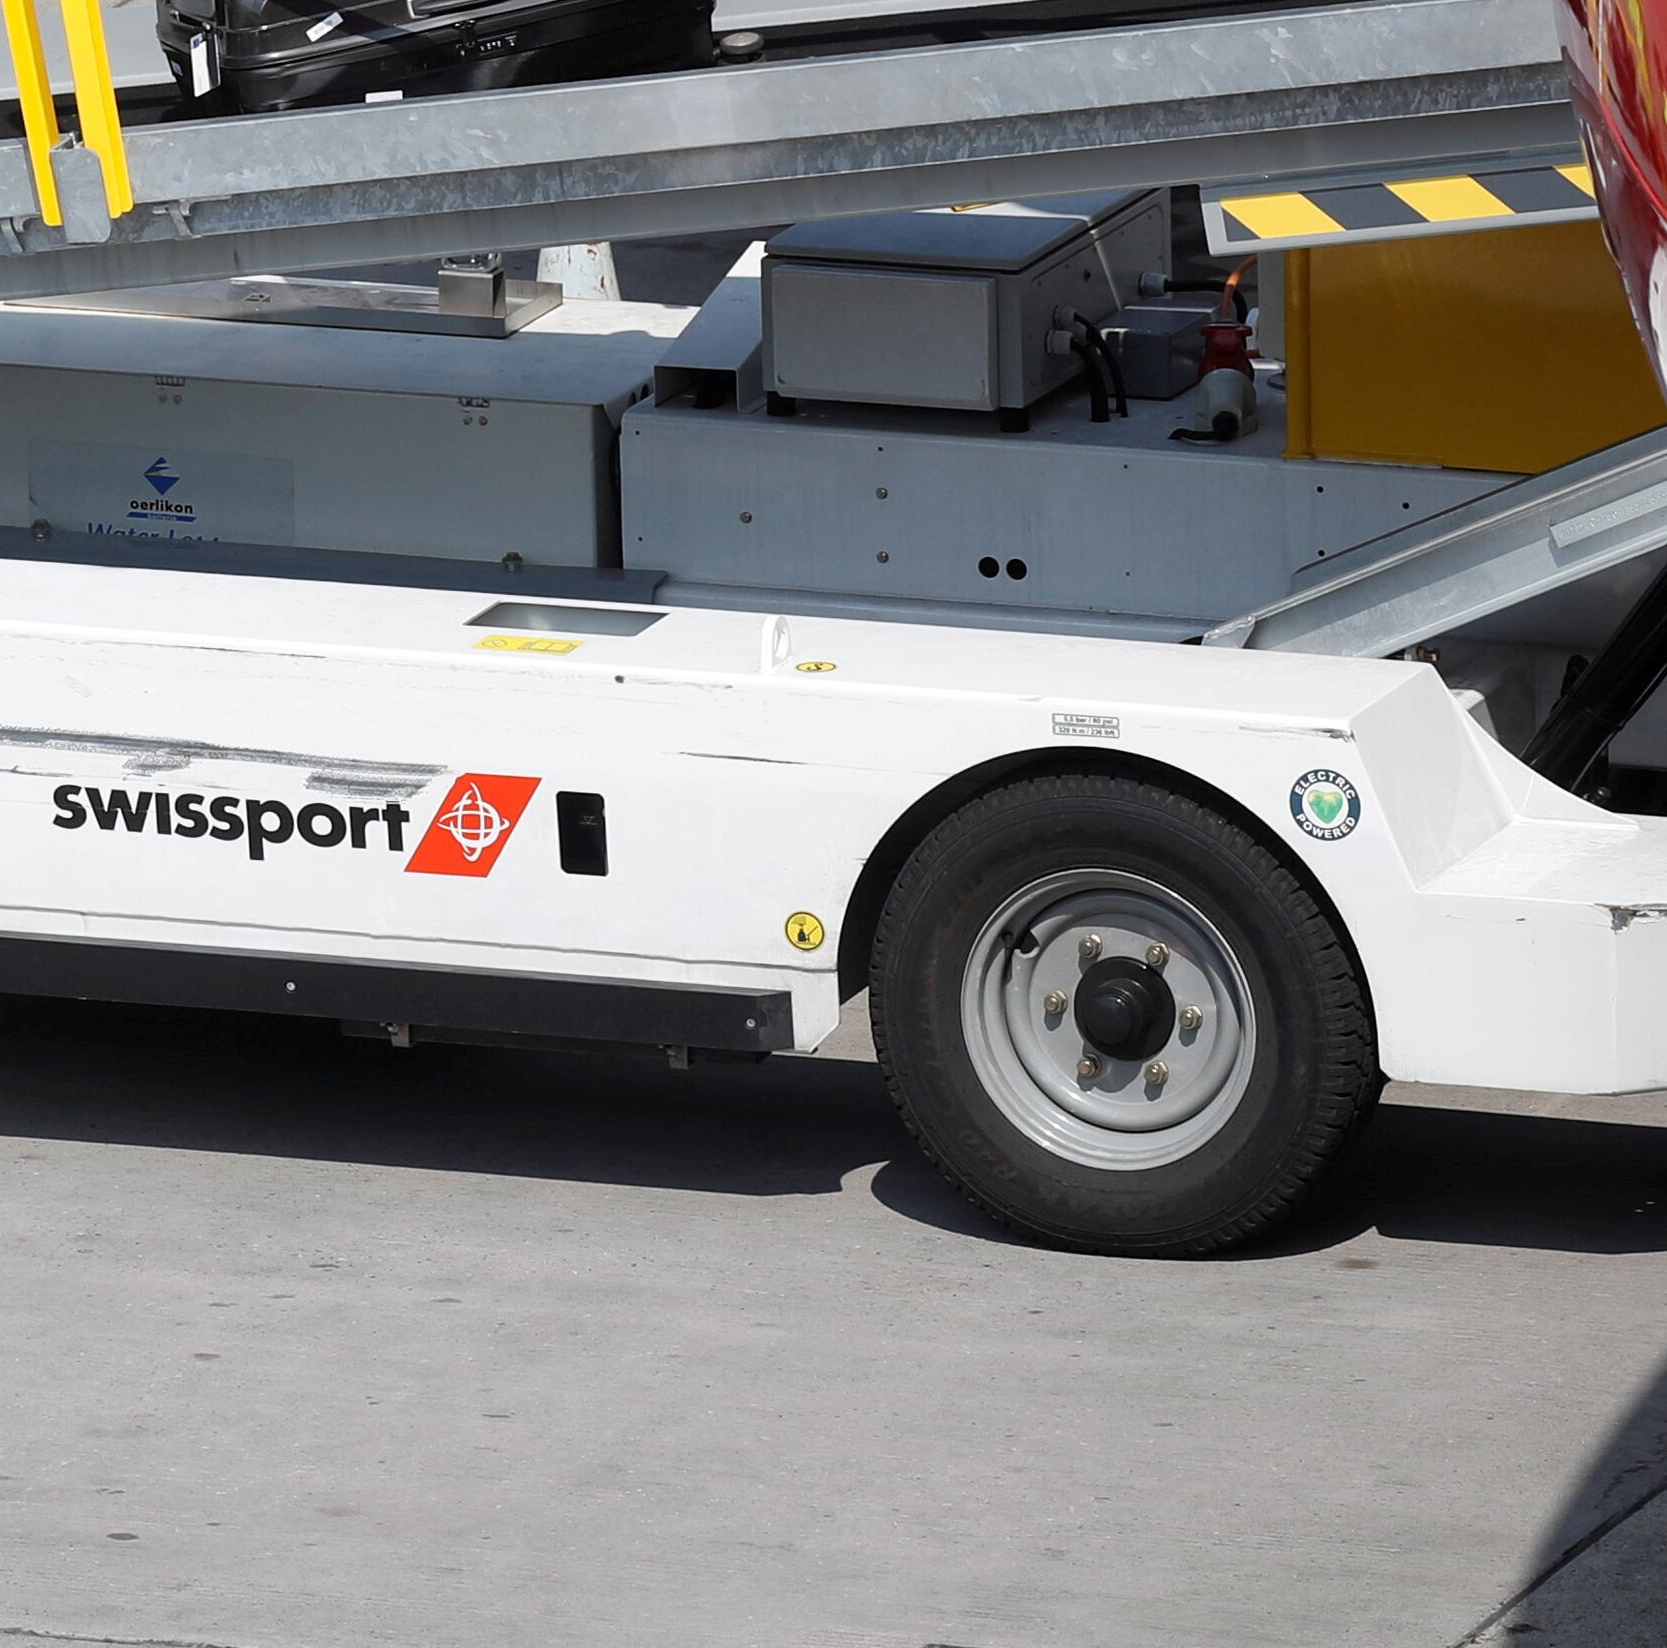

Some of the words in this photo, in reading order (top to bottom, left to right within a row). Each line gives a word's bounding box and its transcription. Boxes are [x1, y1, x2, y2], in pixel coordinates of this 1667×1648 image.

[130, 499, 194, 514] oerlikon
[1294, 771, 1356, 799] ELECTRIC
[52, 784, 411, 861] swissport
[1296, 813, 1356, 839] POWERED
